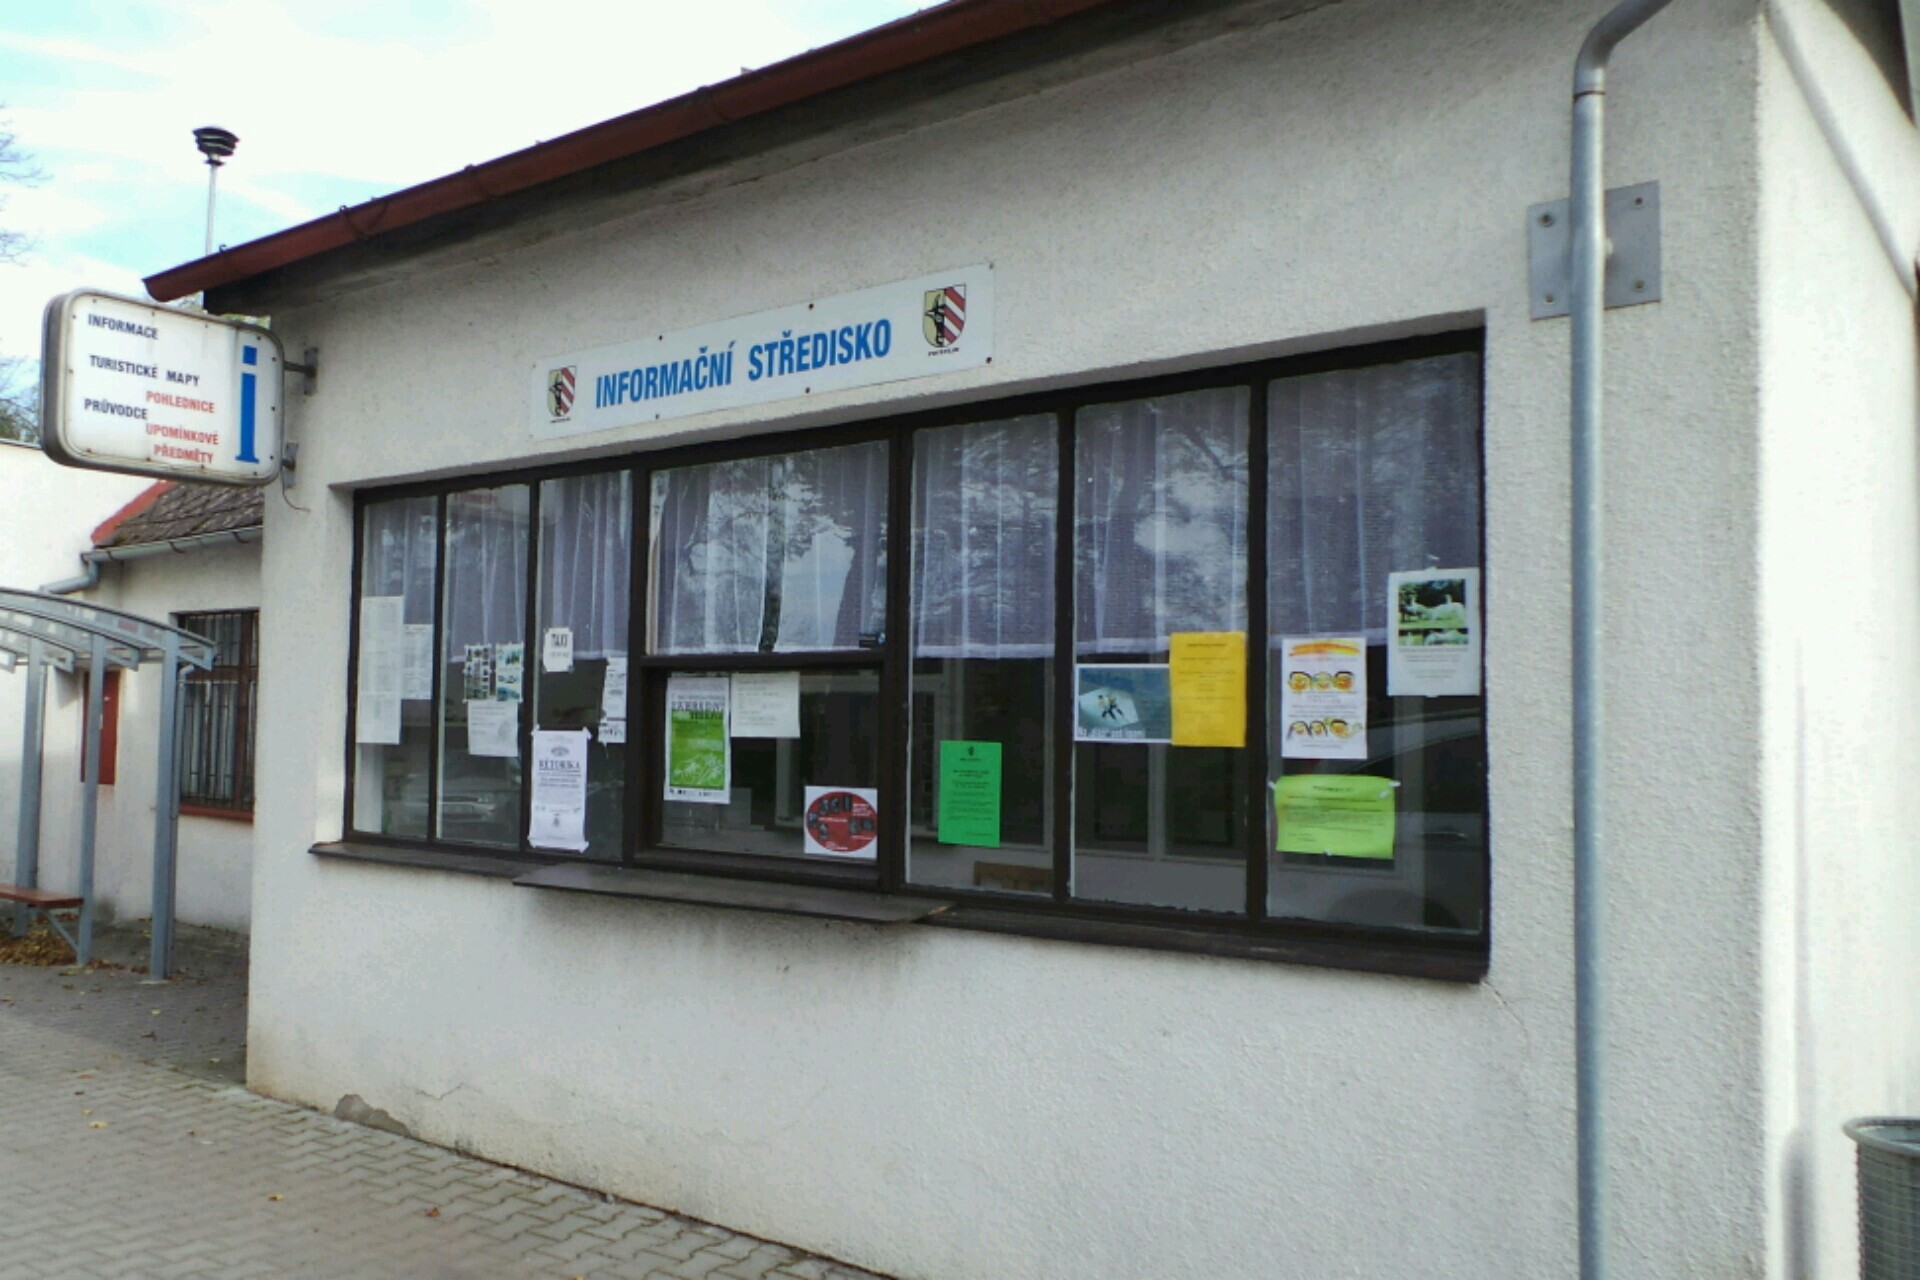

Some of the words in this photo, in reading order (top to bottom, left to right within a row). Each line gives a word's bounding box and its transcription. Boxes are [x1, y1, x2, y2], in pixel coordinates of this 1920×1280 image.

[88, 314, 158, 339] INFORMACE
[90, 355, 158, 379] TURISTICKÉ
[166, 370, 200, 386] MAPY
[595, 341, 736, 408] INFORMAČNÍ
[748, 319, 891, 381] STŘEDISKO
[146, 391, 215, 413] POHLEDNICE
[146, 423, 219, 445] UPOMÍNKOVÉ
[153, 444, 213, 463] PŘEDMĚTY
